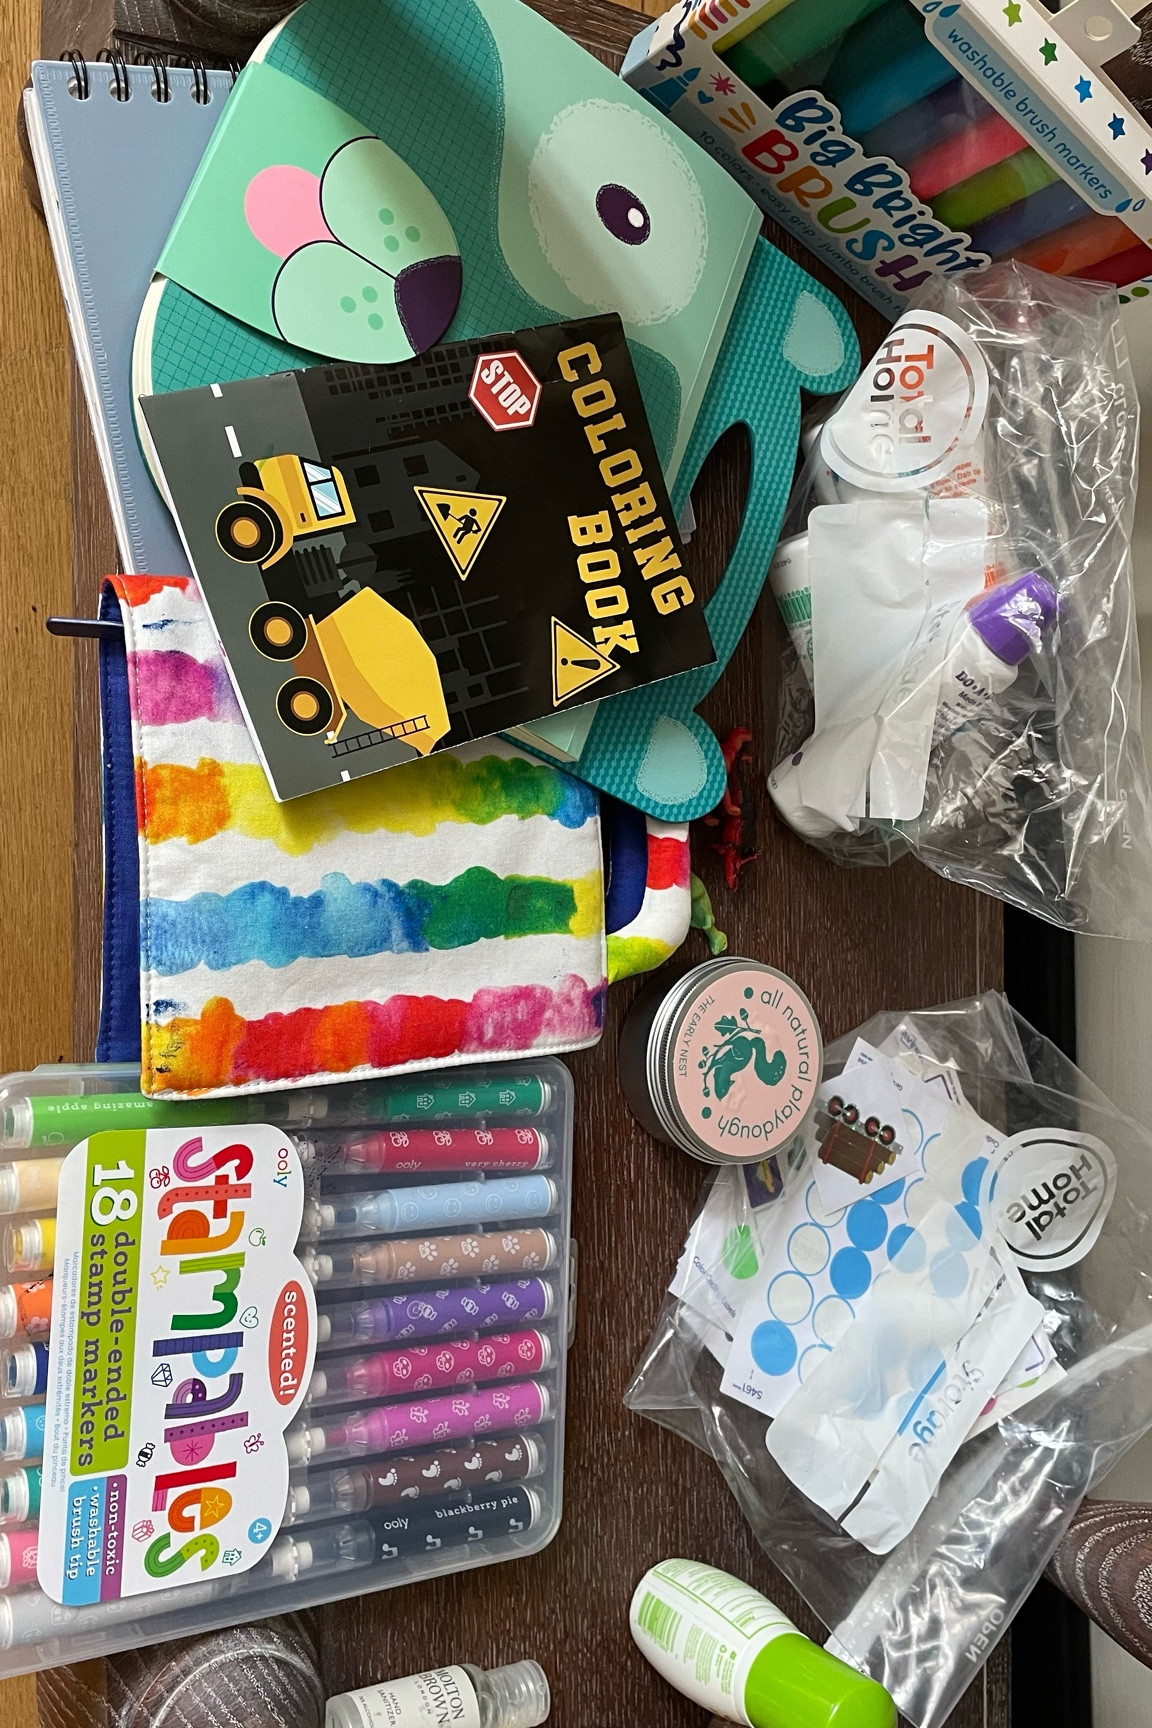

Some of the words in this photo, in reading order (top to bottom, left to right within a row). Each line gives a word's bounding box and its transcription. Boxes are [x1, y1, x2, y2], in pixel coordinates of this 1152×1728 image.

[947, 28, 1017, 100] washable
[1015, 97, 1058, 143] brush
[1054, 142, 1112, 199] markers
[742, 129, 932, 292] BRUSH
[775, 96, 855, 168] Big
[844, 163, 985, 273] Bright
[700, 130, 715, 145] 10
[717, 145, 754, 182] colors
[760, 187, 790, 214] easy
[789, 213, 816, 239] grip
[818, 241, 860, 276] jumbo
[859, 275, 893, 306] brush
[480, 359, 532, 417] STOP
[557, 341, 695, 616] COLORING
[567, 510, 640, 658] BOOK
[700, 995, 716, 1013] THE
[760, 989, 784, 1010] all
[684, 1014, 701, 1046] EARLY
[782, 1005, 812, 1083] natural
[678, 1049, 688, 1078] NEST
[47, 1103, 89, 1113] apple
[93, 1101, 154, 1112] amazing
[718, 1084, 804, 1141] playdough
[273, 1148, 292, 1188] ooly
[395, 1160, 422, 1170] ooly
[465, 1160, 488, 1168] very
[492, 1160, 530, 1168] cherry
[1006, 1153, 1093, 1223] Home
[89, 1160, 138, 1227] 18
[1025, 1179, 1098, 1241] Total
[70, 1251, 79, 1298] Marcadores
[81, 1233, 108, 1328] stamp
[66, 1358, 73, 1368] de
[104, 1231, 136, 1443] double-ended
[144, 1136, 254, 1578] stampables
[279, 1290, 298, 1396] scented!
[65, 1369, 73, 1391] doble
[78, 1338, 103, 1467] markers
[60, 1456, 67, 1466] de
[61, 1431, 69, 1457] Punta
[70, 1495, 87, 1550] brush
[105, 1490, 120, 1576] non-toxic
[253, 1522, 268, 1540] 4+
[383, 1517, 409, 1530] ooly
[434, 1499, 498, 1519] blackberry
[501, 1495, 519, 1508] pie
[86, 1493, 102, 1577] washable
[66, 1553, 83, 1581] tip
[376, 1689, 396, 1727] SANITIZER
[388, 1692, 402, 1715] HAND
[414, 1680, 434, 1715] LONDON
[418, 1672, 450, 1725] BROWN
[433, 1668, 465, 1720] MOLTON
